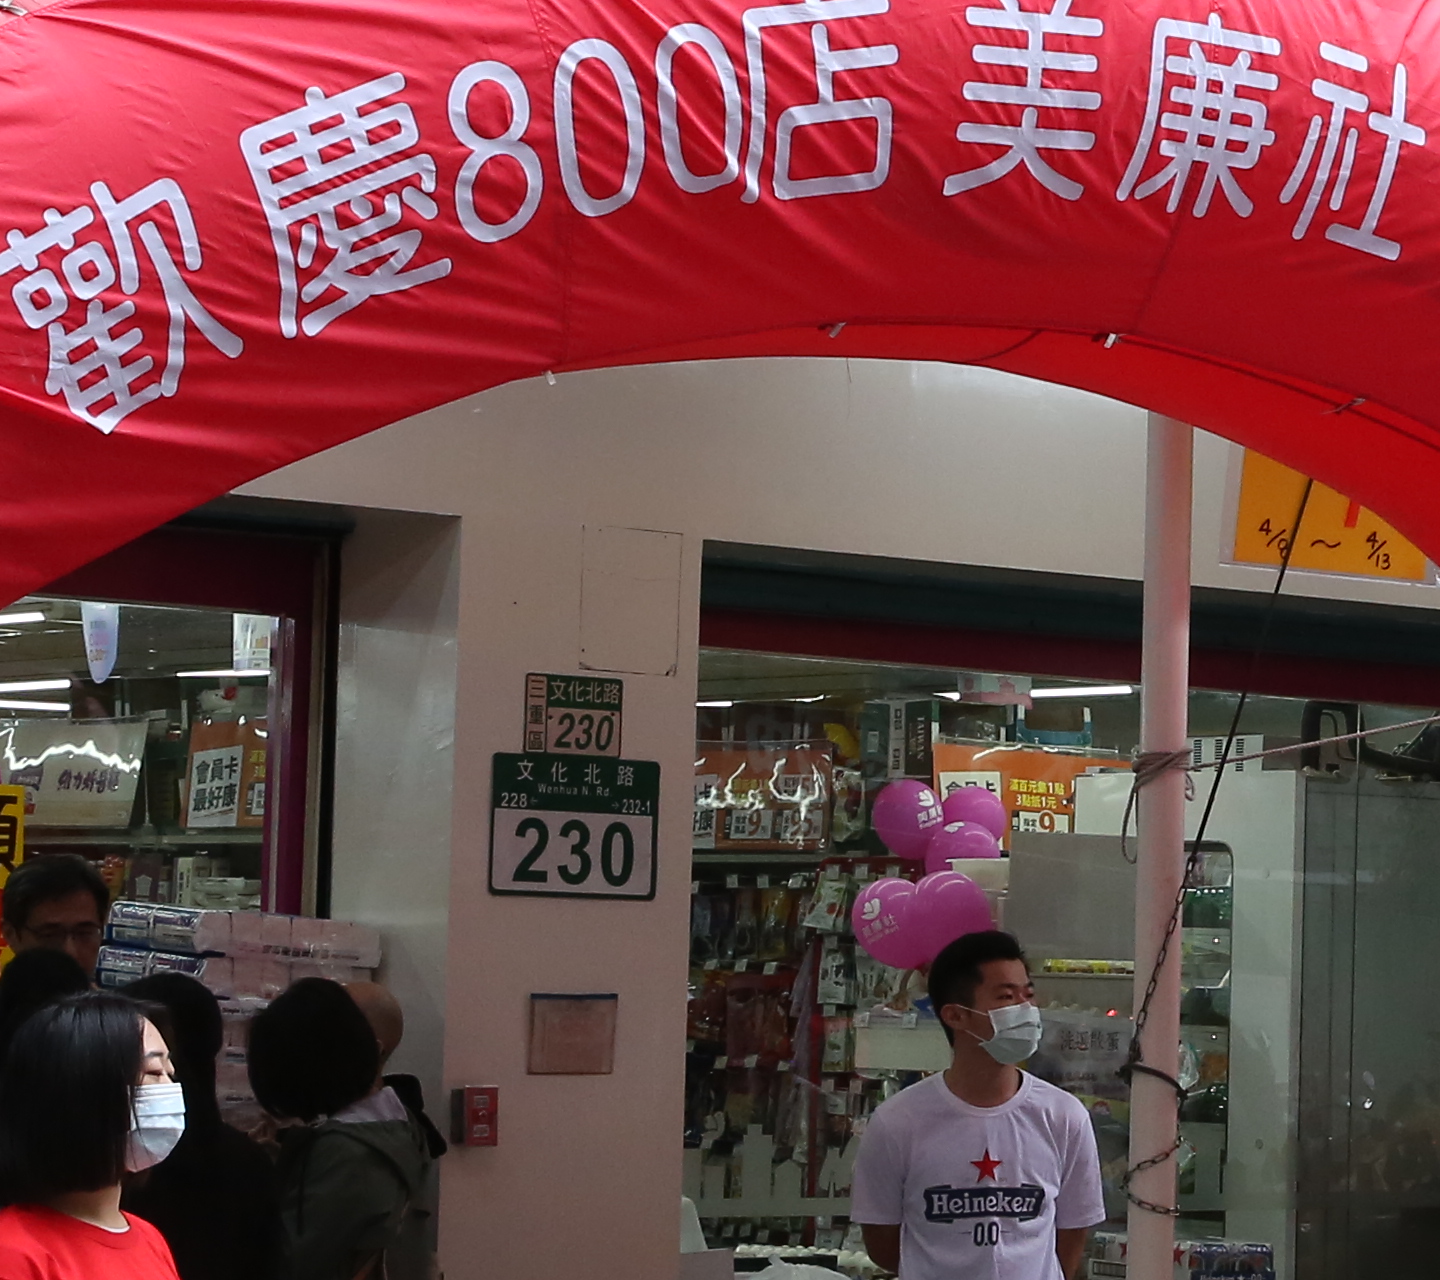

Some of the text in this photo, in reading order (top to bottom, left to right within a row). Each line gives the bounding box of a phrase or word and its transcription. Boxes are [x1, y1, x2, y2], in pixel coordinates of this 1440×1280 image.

[1258, 518, 1391, 570] 4/8 4/13
[549, 678, 620, 705] 文化北路
[527, 678, 545, 752] 三重區
[554, 712, 615, 752] 230
[195, 756, 239, 786] 會員卡
[516, 759, 635, 787] 文化北路
[193, 782, 237, 812] 最好康
[500, 791, 651, 815] 228 232-1
[538, 782, 579, 796] Wenhua
[512, 816, 634, 887] 230
[931, 1191, 1035, 1215] Heineken
[972, 1221, 1000, 1247] 0.0
